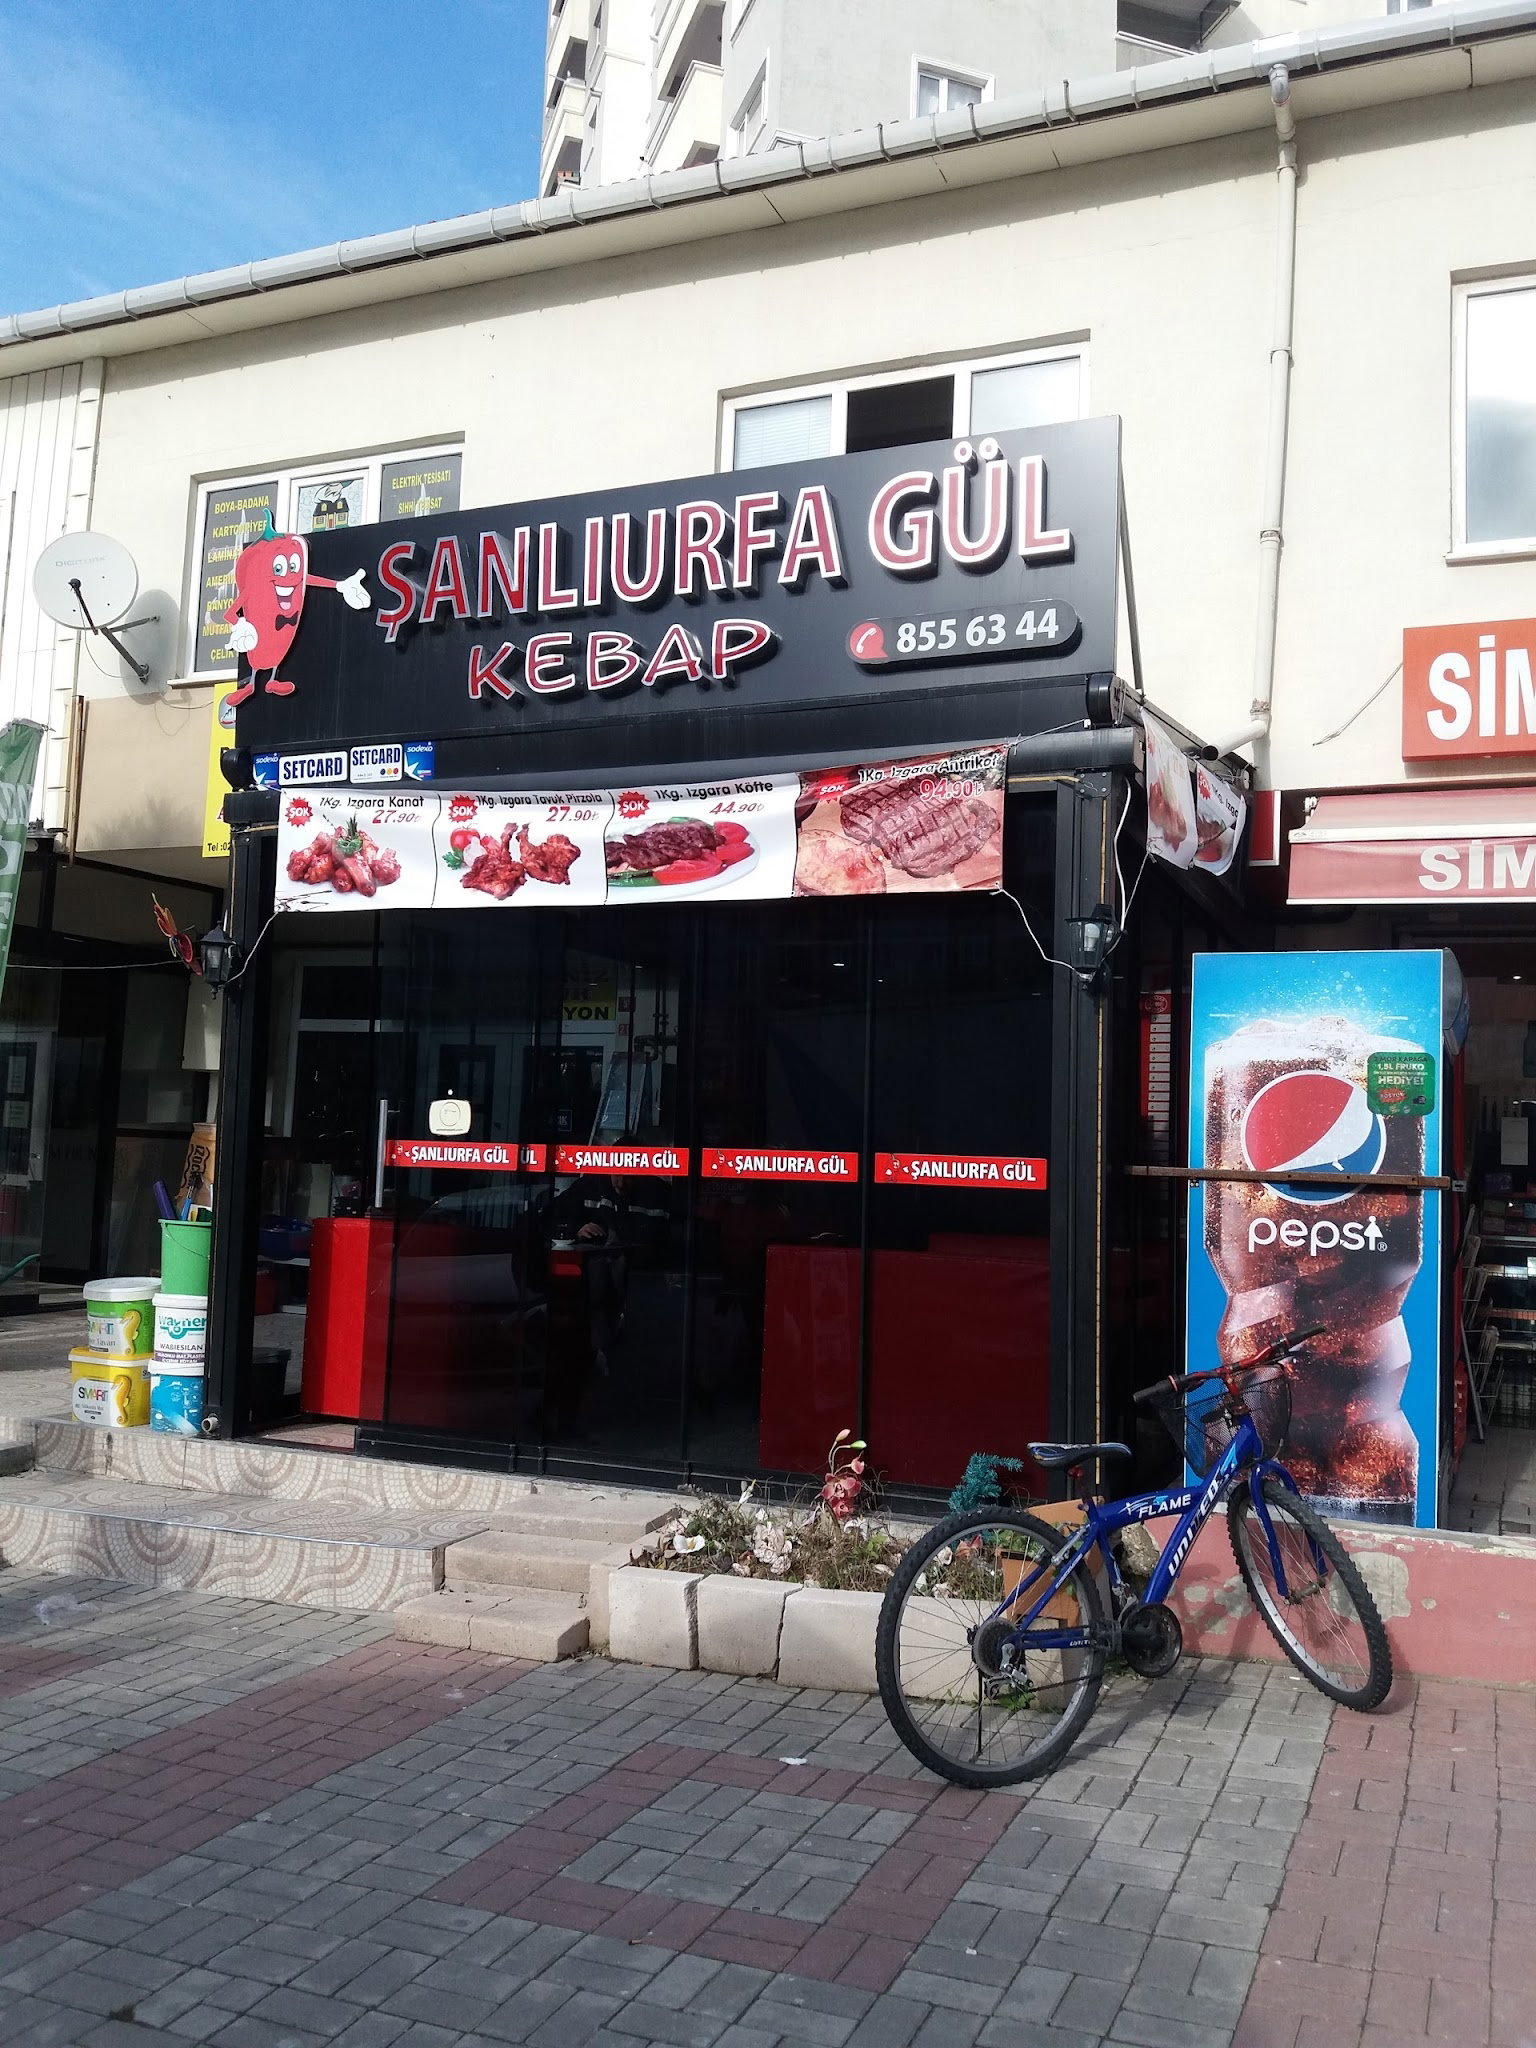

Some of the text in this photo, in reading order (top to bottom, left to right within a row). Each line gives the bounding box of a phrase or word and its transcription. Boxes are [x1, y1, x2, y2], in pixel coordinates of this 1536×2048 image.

[392, 470, 451, 489] ELEKTRİK TESİSATI
[214, 496, 269, 514] BOYA-BADANA
[375, 437, 1062, 644] ŞANLIURFA GÜL
[896, 608, 1059, 653] 855 63 44
[467, 618, 773, 700] KEBAP
[352, 747, 401, 766] SETCARD
[406, 743, 433, 753] sodexo
[255, 753, 279, 764] sodexo
[283, 757, 343, 780] SETCARD
[735, 781, 773, 795] Köfte
[389, 796, 424, 807] Kanat
[534, 794, 564, 805] Tavuk
[567, 793, 603, 804] Pirzola
[207, 843, 219, 851] Tel
[411, 1146, 510, 1164] ŞANLIURFA GÜL
[574, 1150, 681, 1169] ŞANLIURFA GÜL
[734, 1155, 849, 1175] ŞANLIURFA GÜL
[910, 1161, 1037, 1182] ŞANLIURFA GÜL
[1138, 1494, 1192, 1519] FLAME
